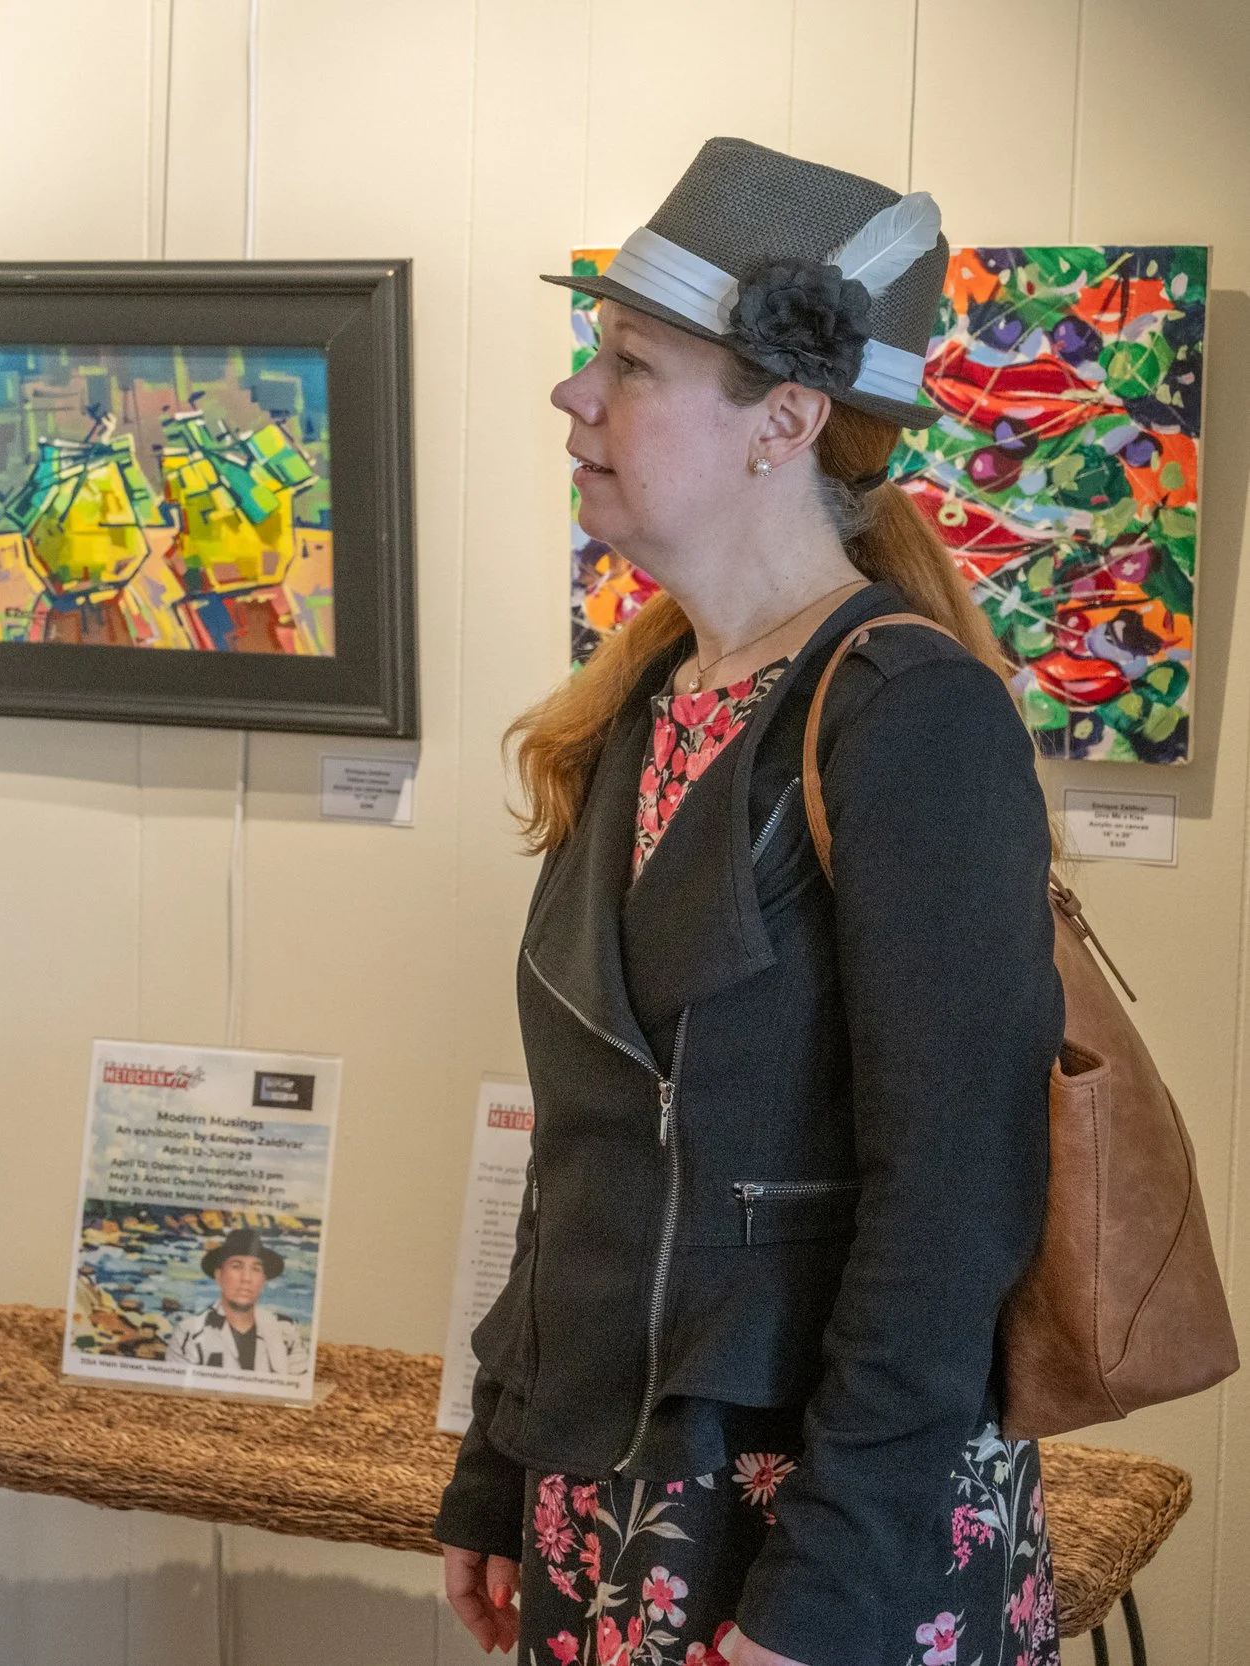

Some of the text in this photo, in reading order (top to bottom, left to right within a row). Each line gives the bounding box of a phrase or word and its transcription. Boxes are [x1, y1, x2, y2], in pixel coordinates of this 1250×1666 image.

[105, 1067, 166, 1086] METUCHEN
[157, 1110, 264, 1132] Modern Musings
[490, 1110, 535, 1131] METUC
[116, 1125, 303, 1151] An exhibition by Enrique Zaldivar
[162, 1145, 190, 1156] April
[111, 1158, 135, 1169] April
[151, 1161, 195, 1175] Opening
[197, 1165, 248, 1178] Reception
[266, 1172, 284, 1181] pm
[110, 1172, 130, 1183] May
[143, 1174, 171, 1184] Artist
[268, 1187, 286, 1196] pm
[108, 1185, 127, 1196] May
[146, 1188, 173, 1199] Artist
[175, 1190, 205, 1202] Music
[207, 1193, 273, 1209] Performance
[281, 1202, 300, 1212] pm
